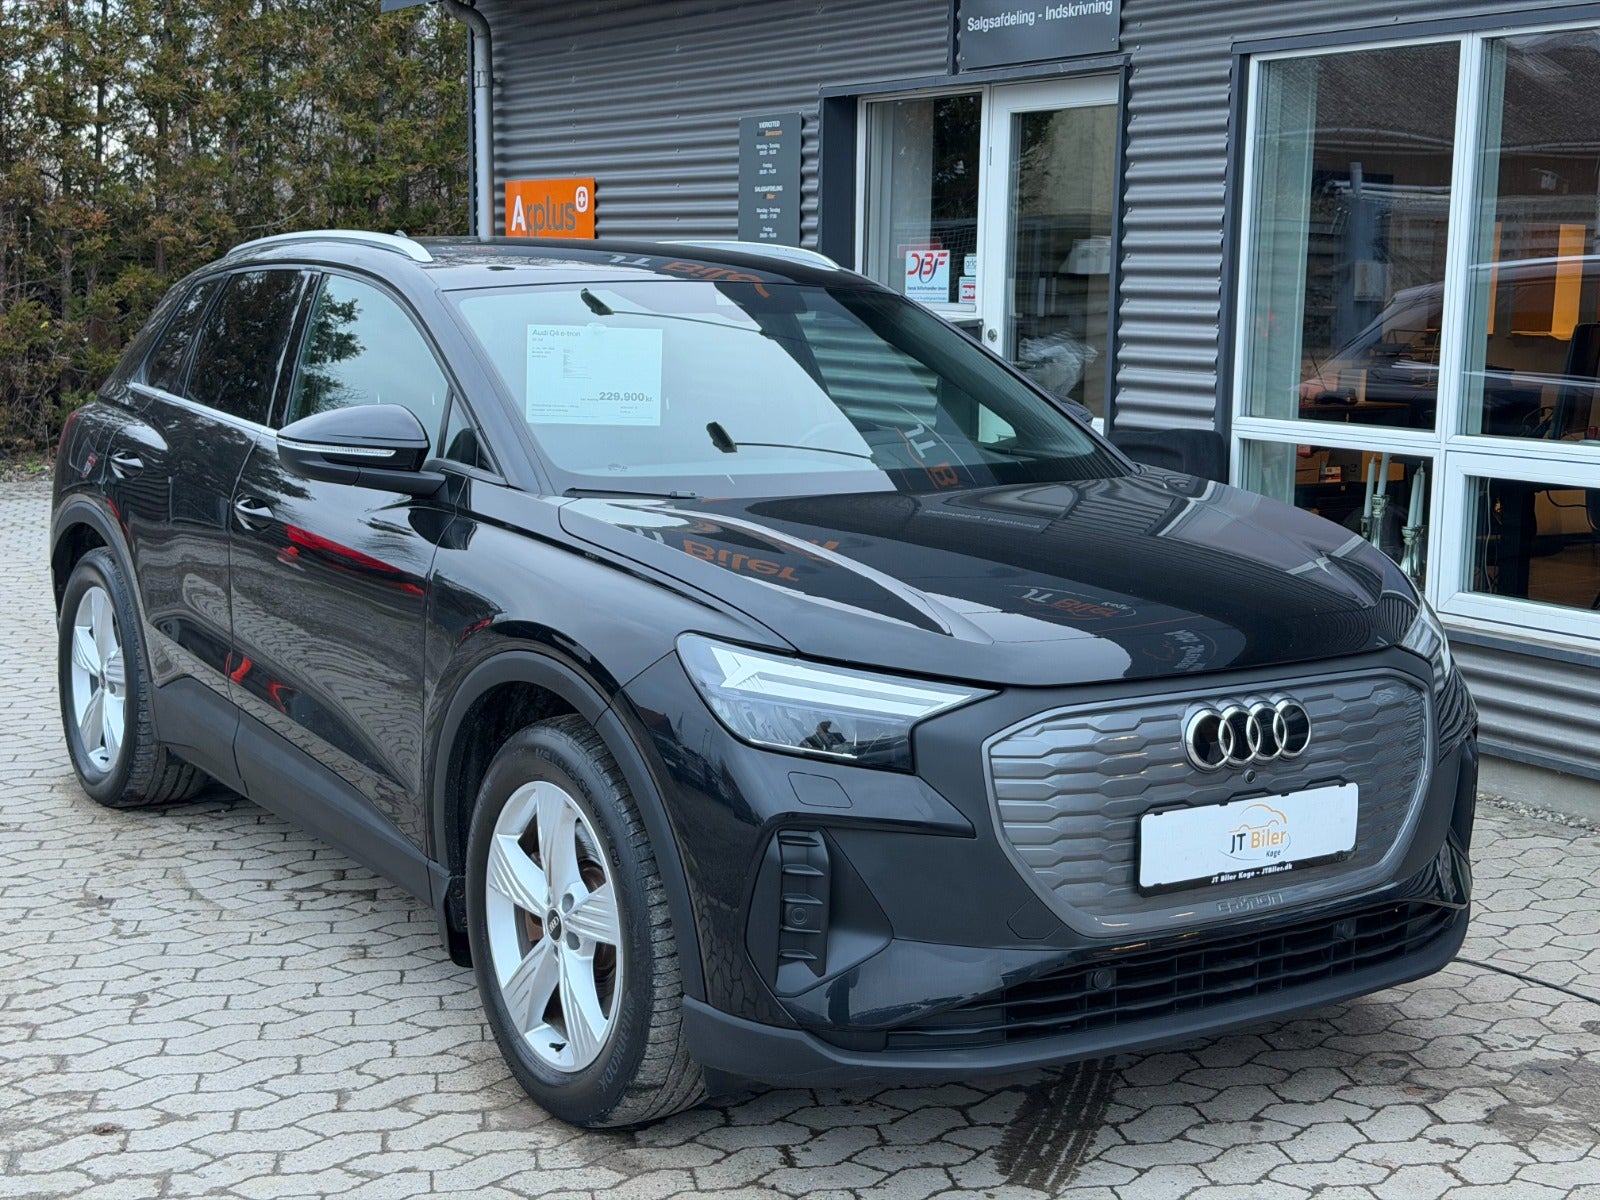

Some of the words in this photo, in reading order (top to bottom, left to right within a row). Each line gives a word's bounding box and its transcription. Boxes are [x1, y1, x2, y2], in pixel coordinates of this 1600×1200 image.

[967, 11, 1035, 32] Salgsafdeling
[1045, 0, 1113, 20] Indskrivning
[599, 392, 645, 402] 229.900
[1230, 832, 1247, 854] JT
[1250, 829, 1287, 849] Biler
[1220, 874, 1237, 882] Biler
